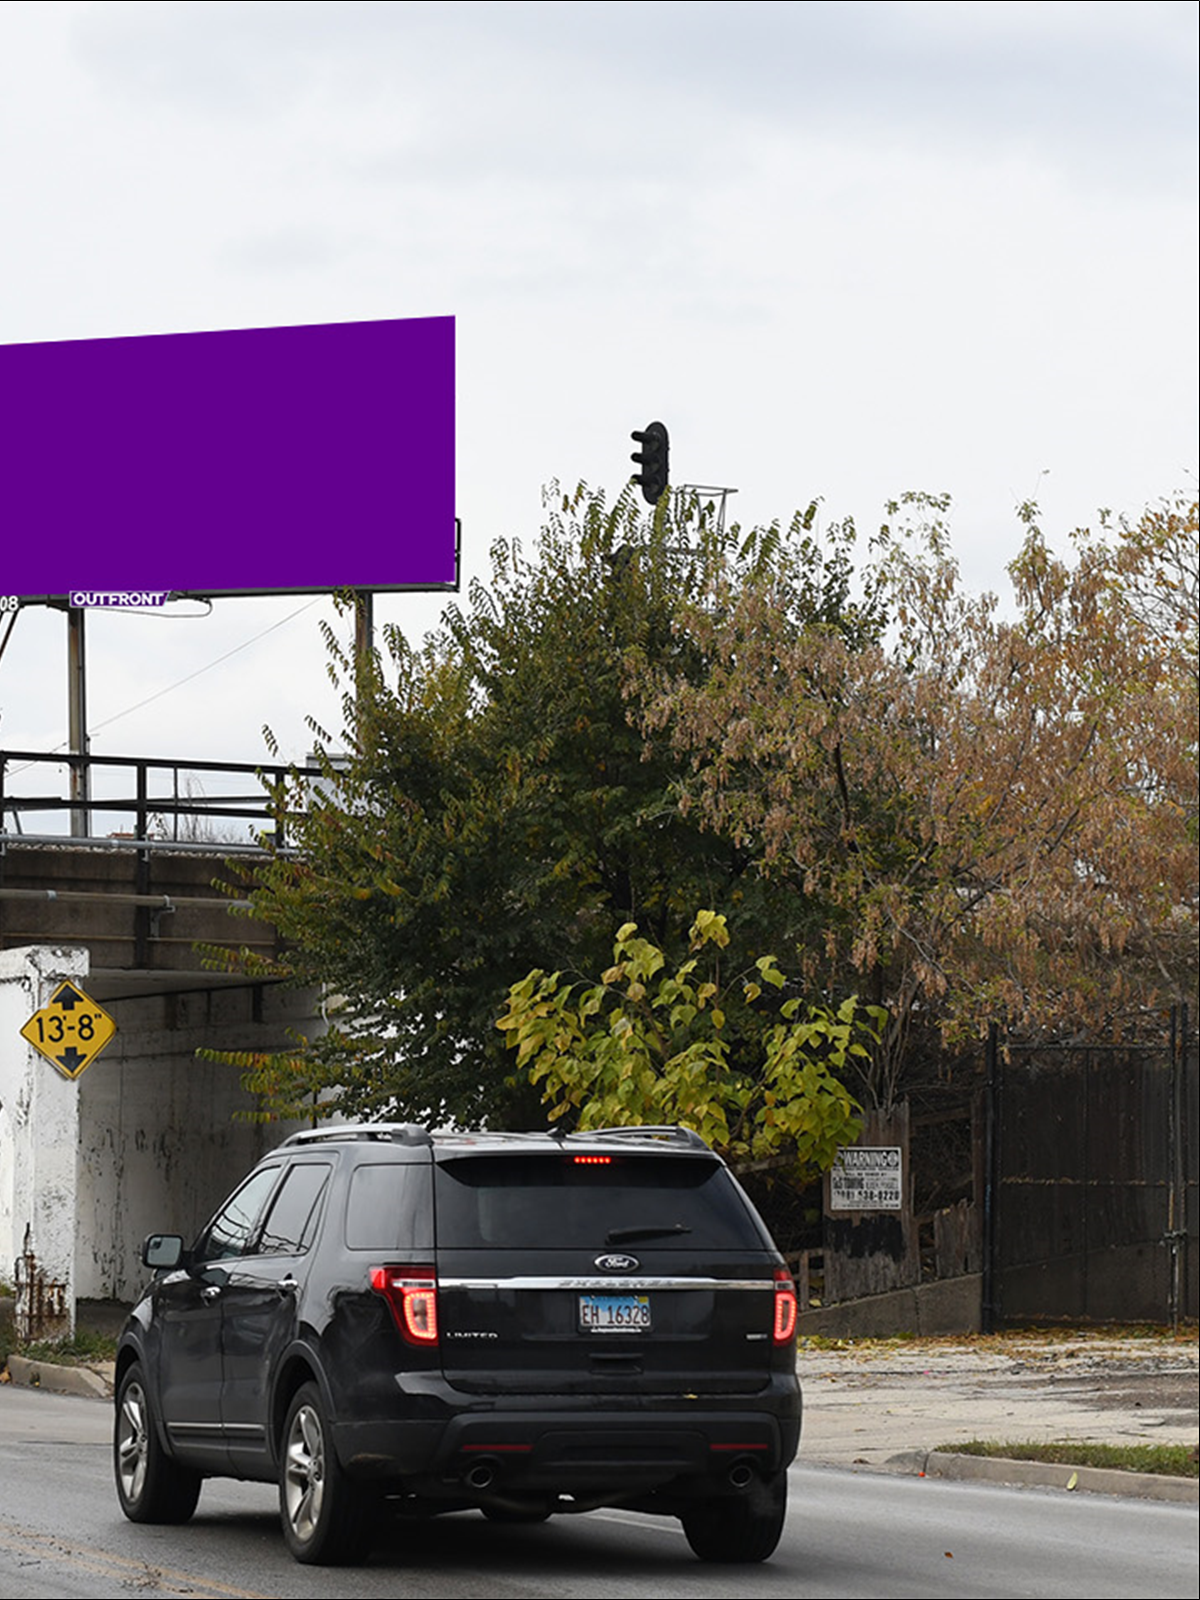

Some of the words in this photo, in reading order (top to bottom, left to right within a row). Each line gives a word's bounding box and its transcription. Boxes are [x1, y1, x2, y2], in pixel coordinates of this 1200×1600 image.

[73, 592, 164, 605] OUTFRONT
[844, 1151, 888, 1167] WARNING
[582, 1304, 599, 1325] EH
[607, 1304, 650, 1325] 16328
